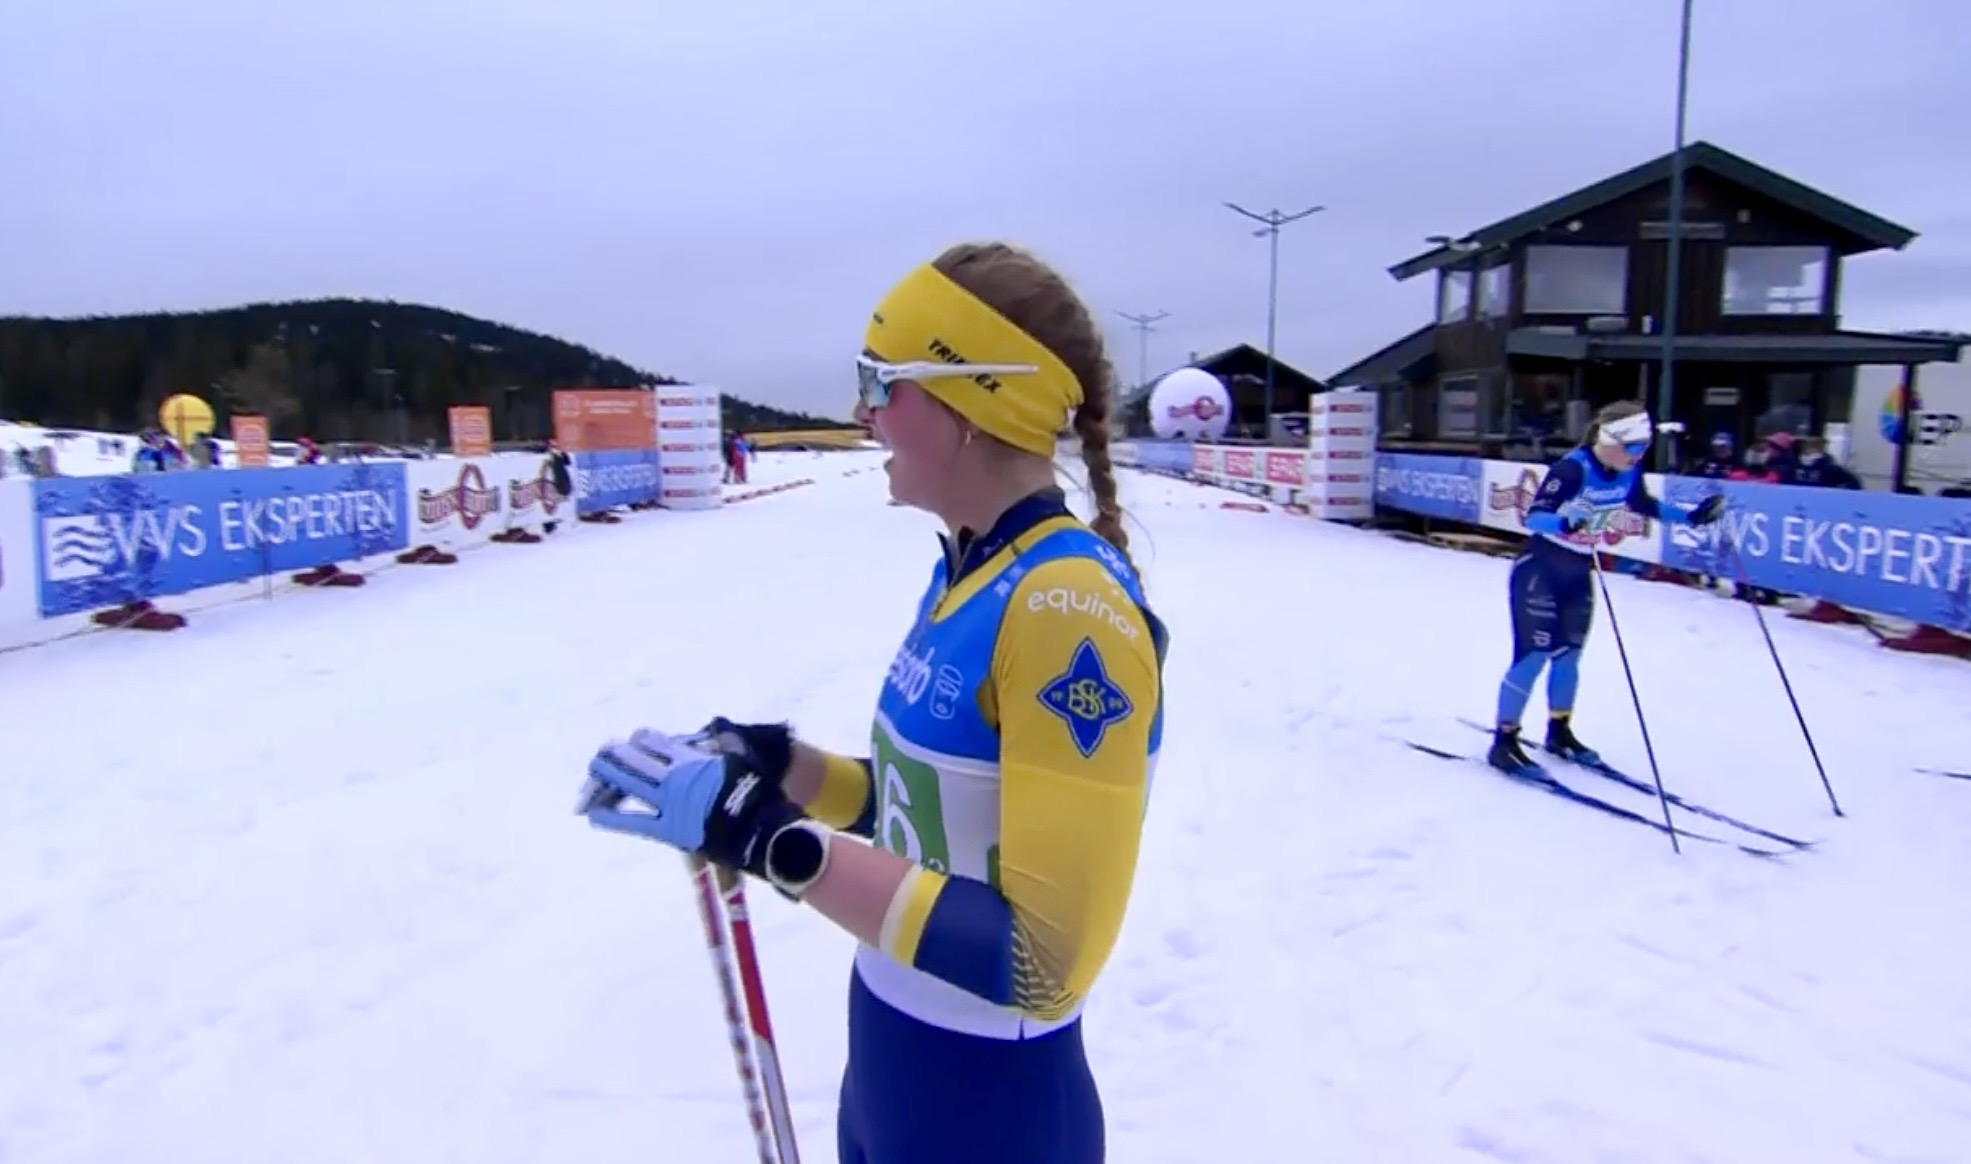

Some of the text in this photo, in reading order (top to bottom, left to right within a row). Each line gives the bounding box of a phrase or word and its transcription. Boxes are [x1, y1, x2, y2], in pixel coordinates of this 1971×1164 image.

[109, 505, 206, 565] VVS
[218, 488, 397, 551] EKSPERTEN
[1780, 515, 1971, 596] EKSPERT
[1027, 587, 1139, 640] equinor
